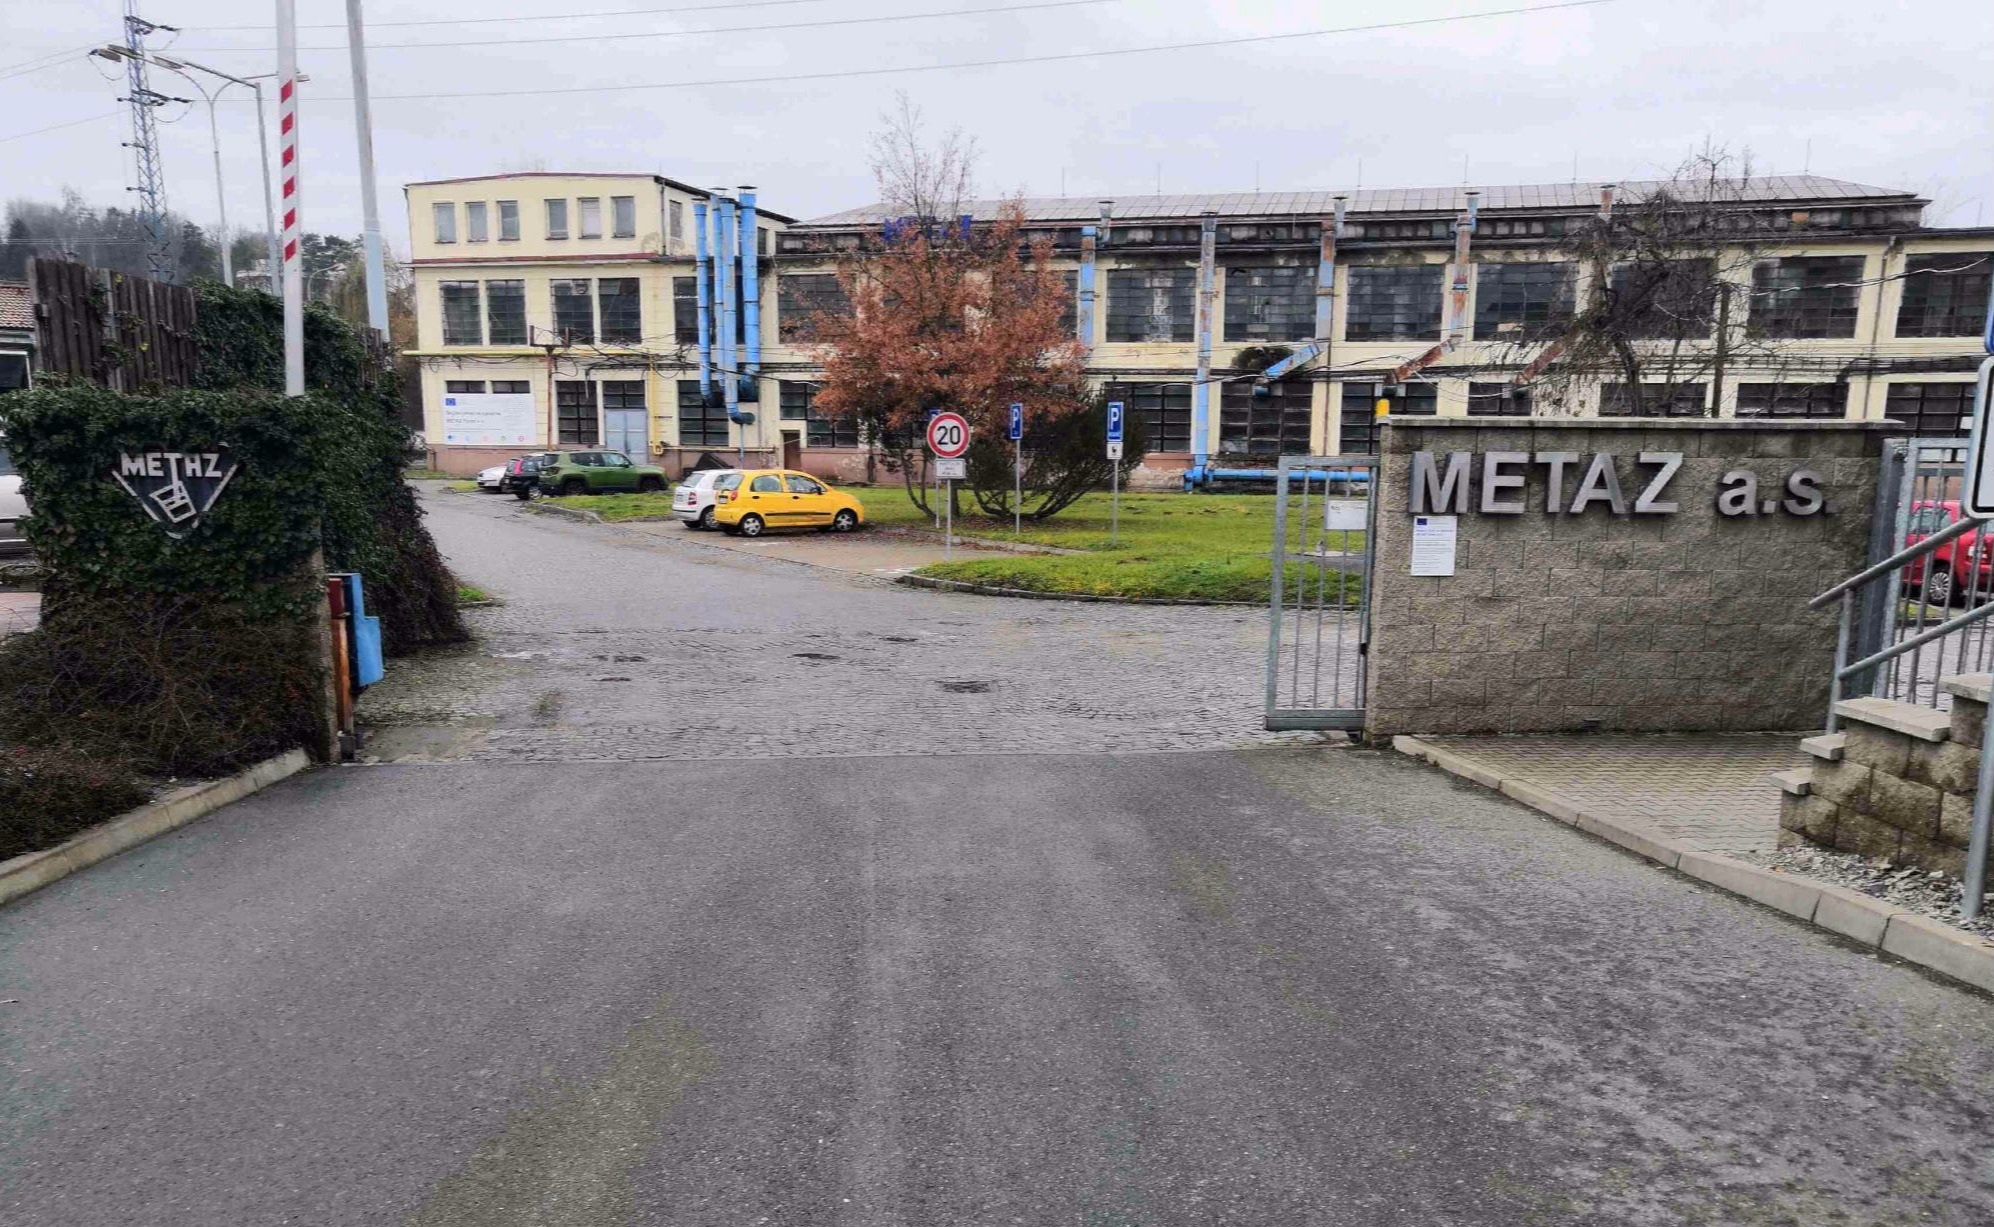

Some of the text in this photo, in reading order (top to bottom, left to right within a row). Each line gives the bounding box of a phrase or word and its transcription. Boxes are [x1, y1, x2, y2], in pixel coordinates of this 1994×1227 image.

[1012, 409, 1019, 428] P
[1110, 407, 1119, 430] P
[937, 425, 960, 445] 20
[1409, 451, 1839, 516] METAZ a.s.
